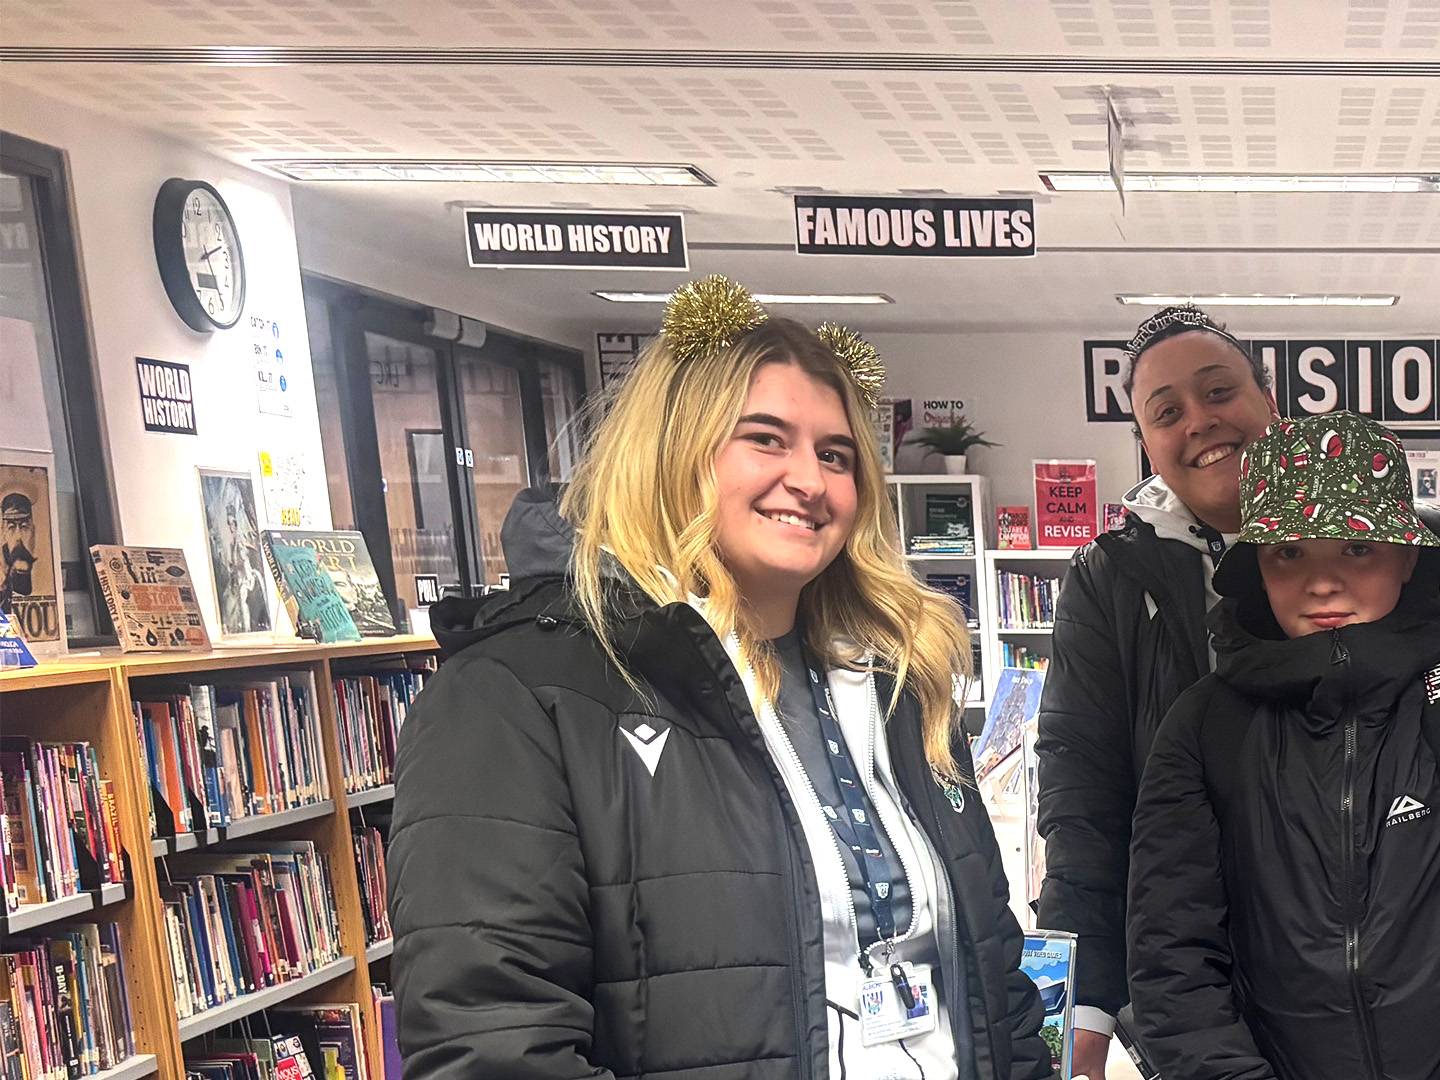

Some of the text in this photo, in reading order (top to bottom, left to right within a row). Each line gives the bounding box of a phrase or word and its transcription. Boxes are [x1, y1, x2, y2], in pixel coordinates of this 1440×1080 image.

[474, 222, 672, 255] WORLD HISTORY
[796, 207, 1034, 248] FAMOUS LIVES
[137, 362, 192, 402] WORLD
[142, 397, 194, 430] HISTORY
[923, 400, 964, 409] HOW TO
[1046, 502, 1087, 514] CALM
[1049, 486, 1083, 499] KEEP
[281, 537, 356, 555] WORLD
[1044, 525, 1091, 538] REVISE
[262, 542, 280, 579] WORLD
[100, 573, 119, 616] HISTORY
[417, 578, 438, 602] PULL
[12, 601, 59, 638] YOU
[107, 793, 119, 829] BRAZIL
[55, 964, 68, 994] D-DAY
